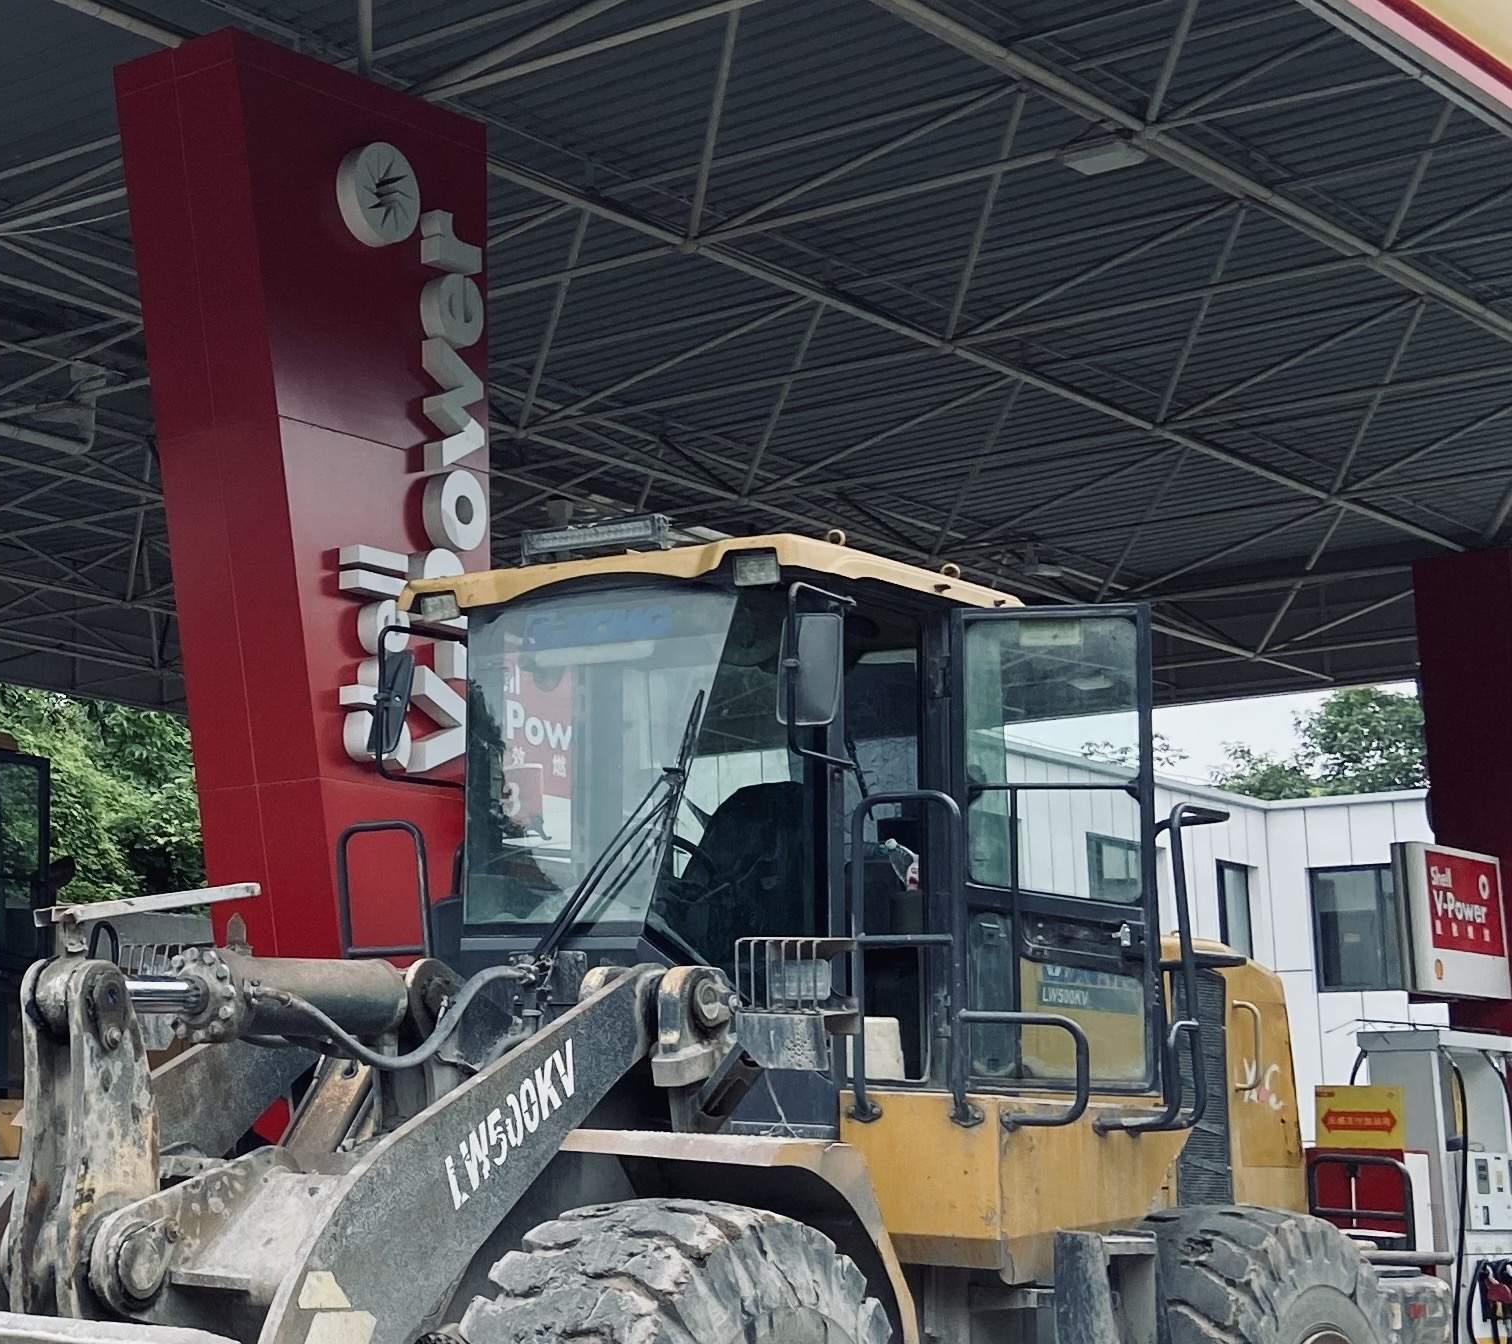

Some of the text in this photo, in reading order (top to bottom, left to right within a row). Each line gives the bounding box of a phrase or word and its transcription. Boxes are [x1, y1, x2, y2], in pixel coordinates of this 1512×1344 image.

[340, 544, 411, 771] Sell
[1430, 865, 1452, 888] Shell
[1432, 890, 1487, 924] V-Power
[444, 1038, 575, 1211] LW500KV
